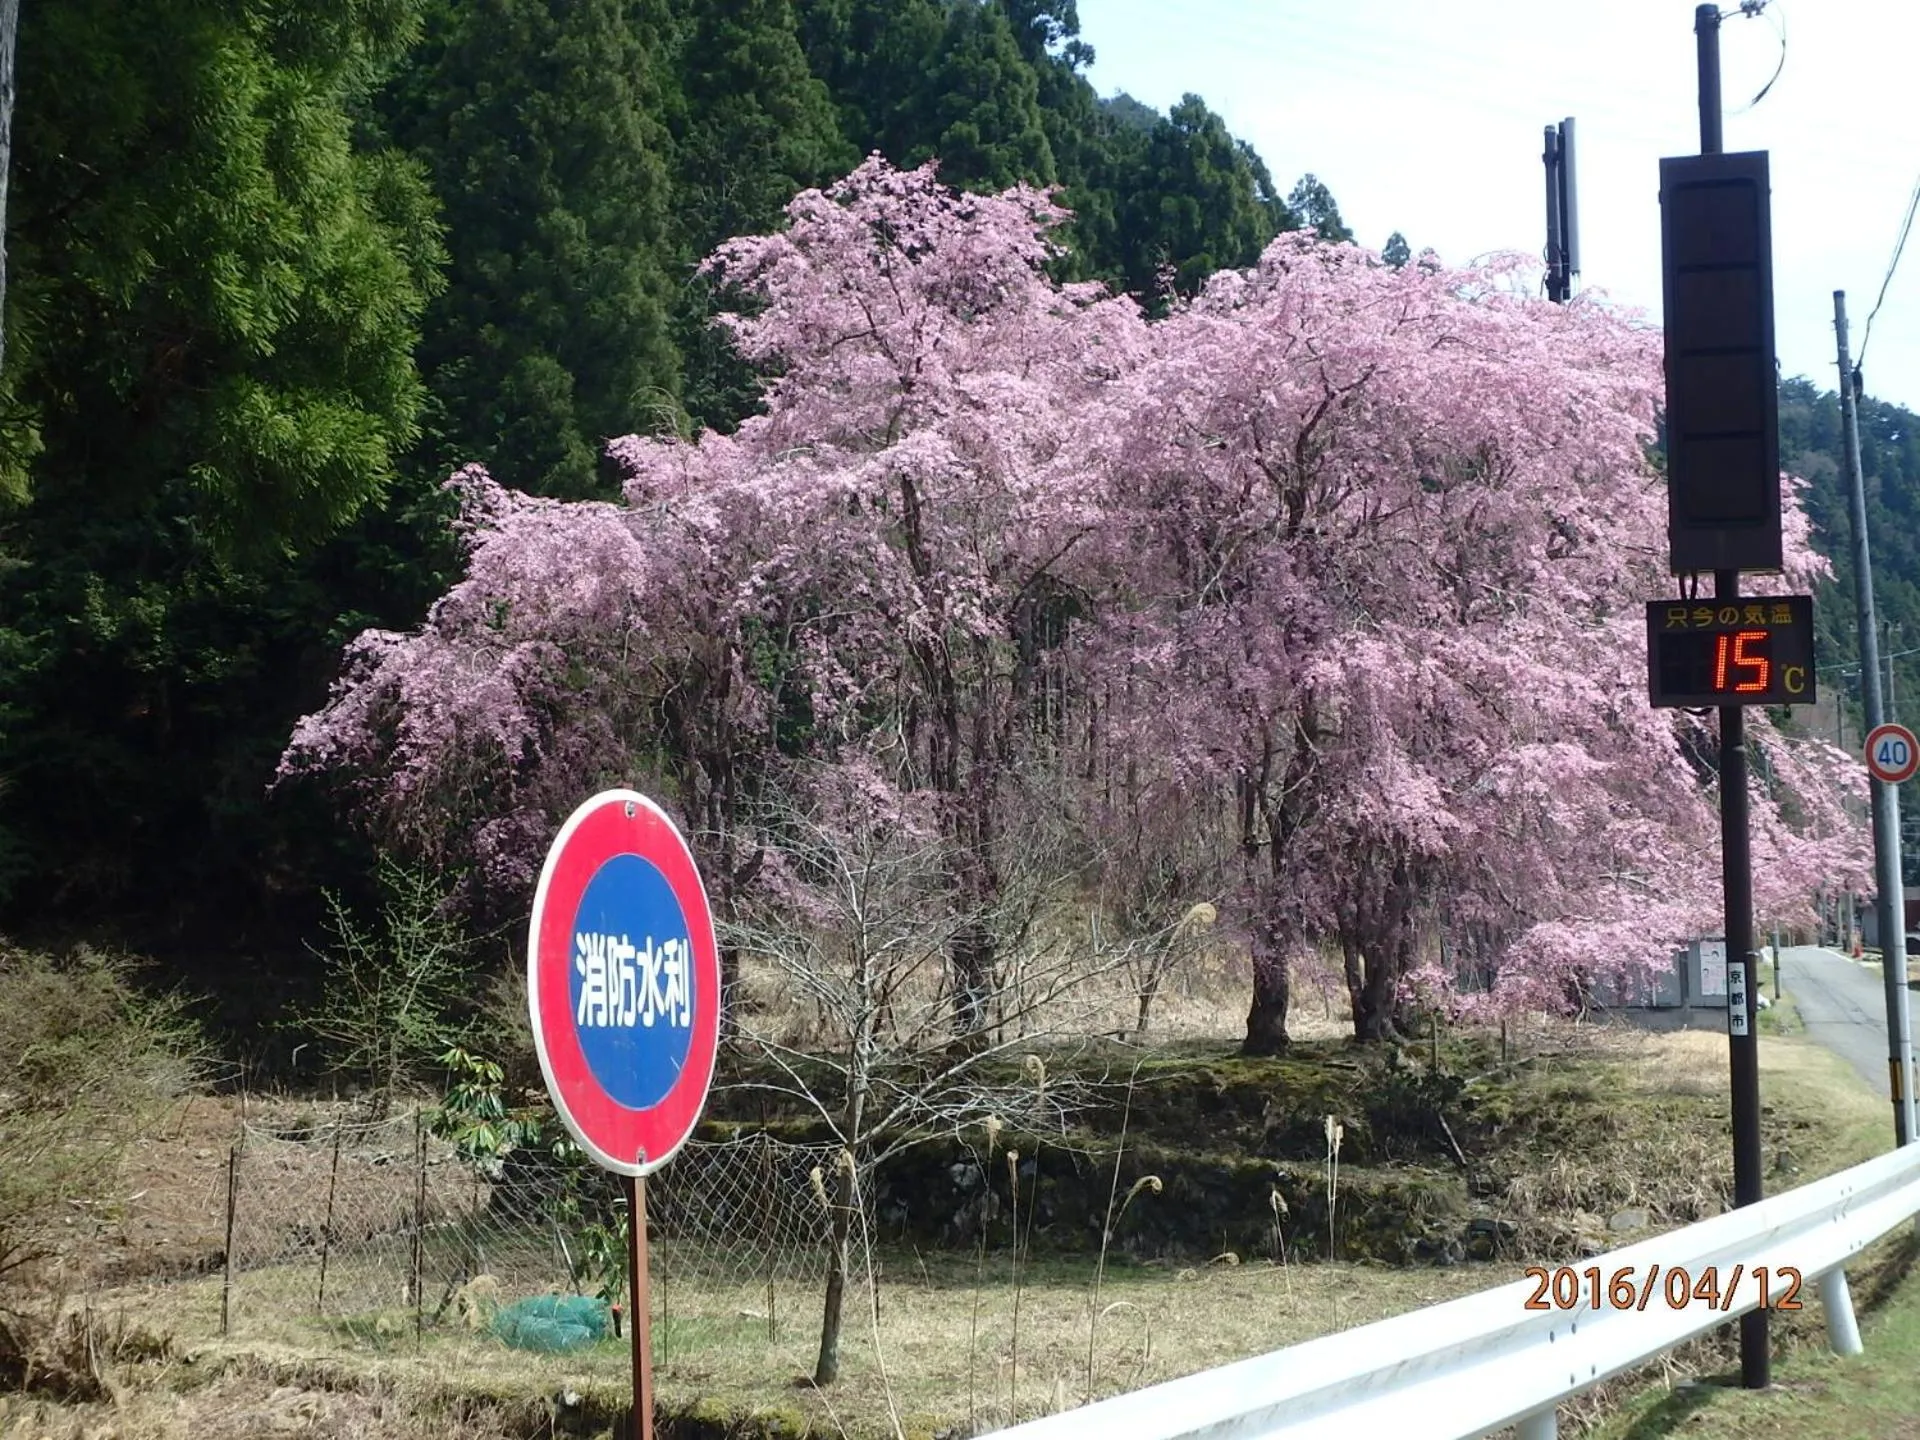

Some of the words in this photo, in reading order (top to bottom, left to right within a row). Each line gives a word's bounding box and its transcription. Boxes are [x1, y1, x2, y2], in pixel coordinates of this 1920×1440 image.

[1666, 604, 1792, 628] 只今の気温
[1715, 631, 1769, 692] 15
[1879, 741, 1907, 765] 40
[575, 931, 690, 1028] 消防水利
[1730, 970, 1745, 1028] 京都市
